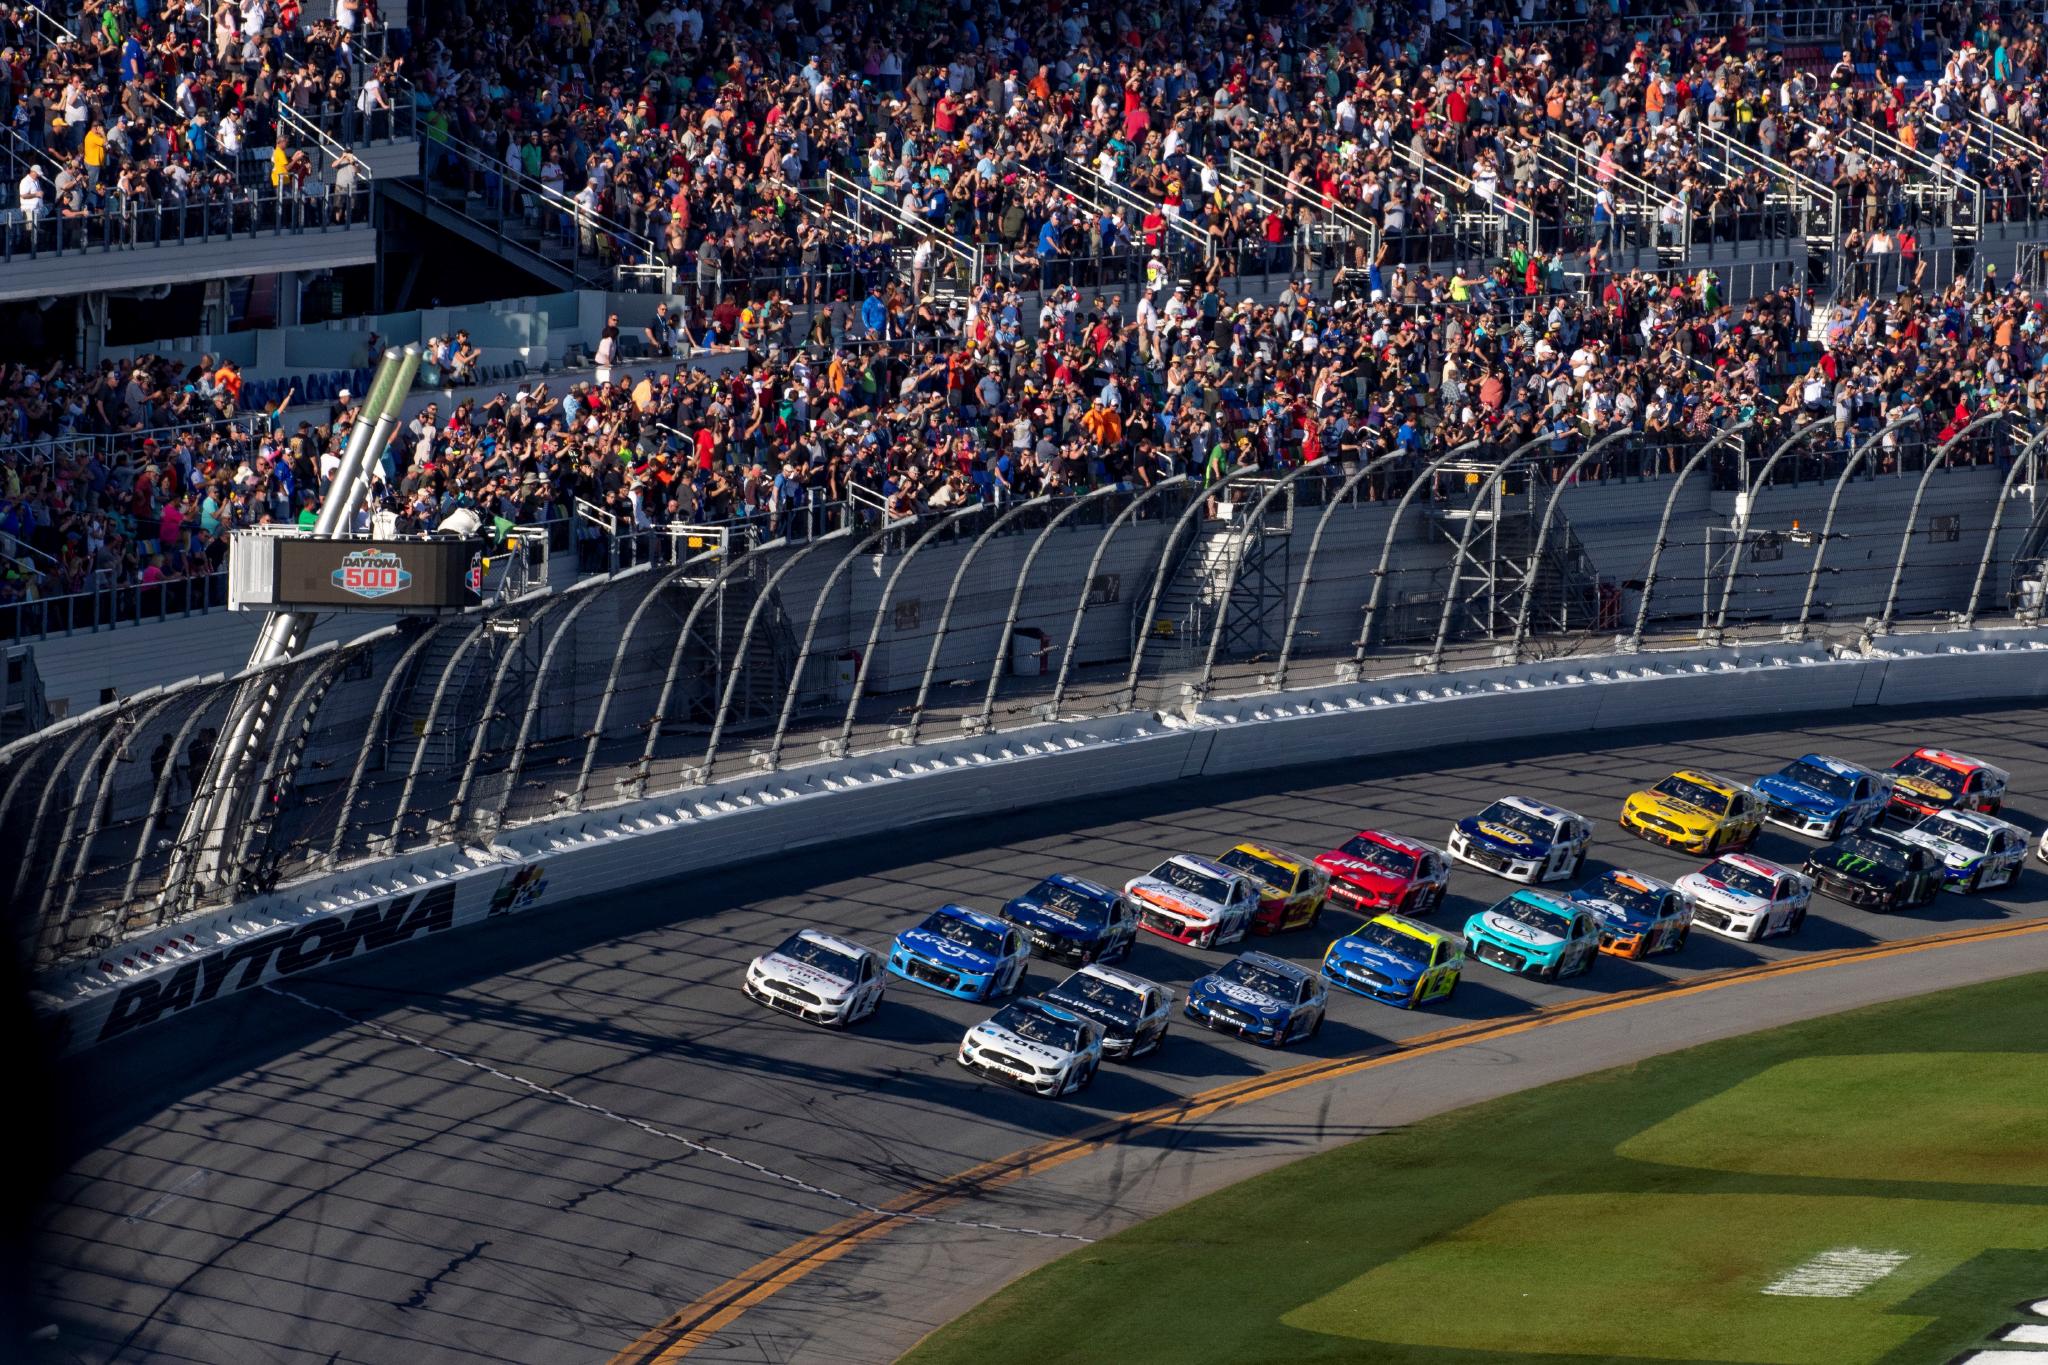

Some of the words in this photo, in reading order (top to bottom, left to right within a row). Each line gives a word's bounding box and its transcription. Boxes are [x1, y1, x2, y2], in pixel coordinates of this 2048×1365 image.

[343, 558, 400, 568] DAYTONA
[346, 568, 397, 588] 500
[1484, 822, 1530, 842] NAPA
[1323, 858, 1407, 879] HAAS
[1552, 847, 1570, 873] 9
[1330, 884, 1363, 902] MUSTANG
[1692, 881, 1748, 906] Valvoline
[905, 931, 991, 966] Kroger
[96, 882, 457, 1042] DAYTONA
[1345, 970, 1383, 988] MUSTANG
[1209, 1009, 1248, 1029] MUSTANG
[998, 1033, 1060, 1060] KOCH
